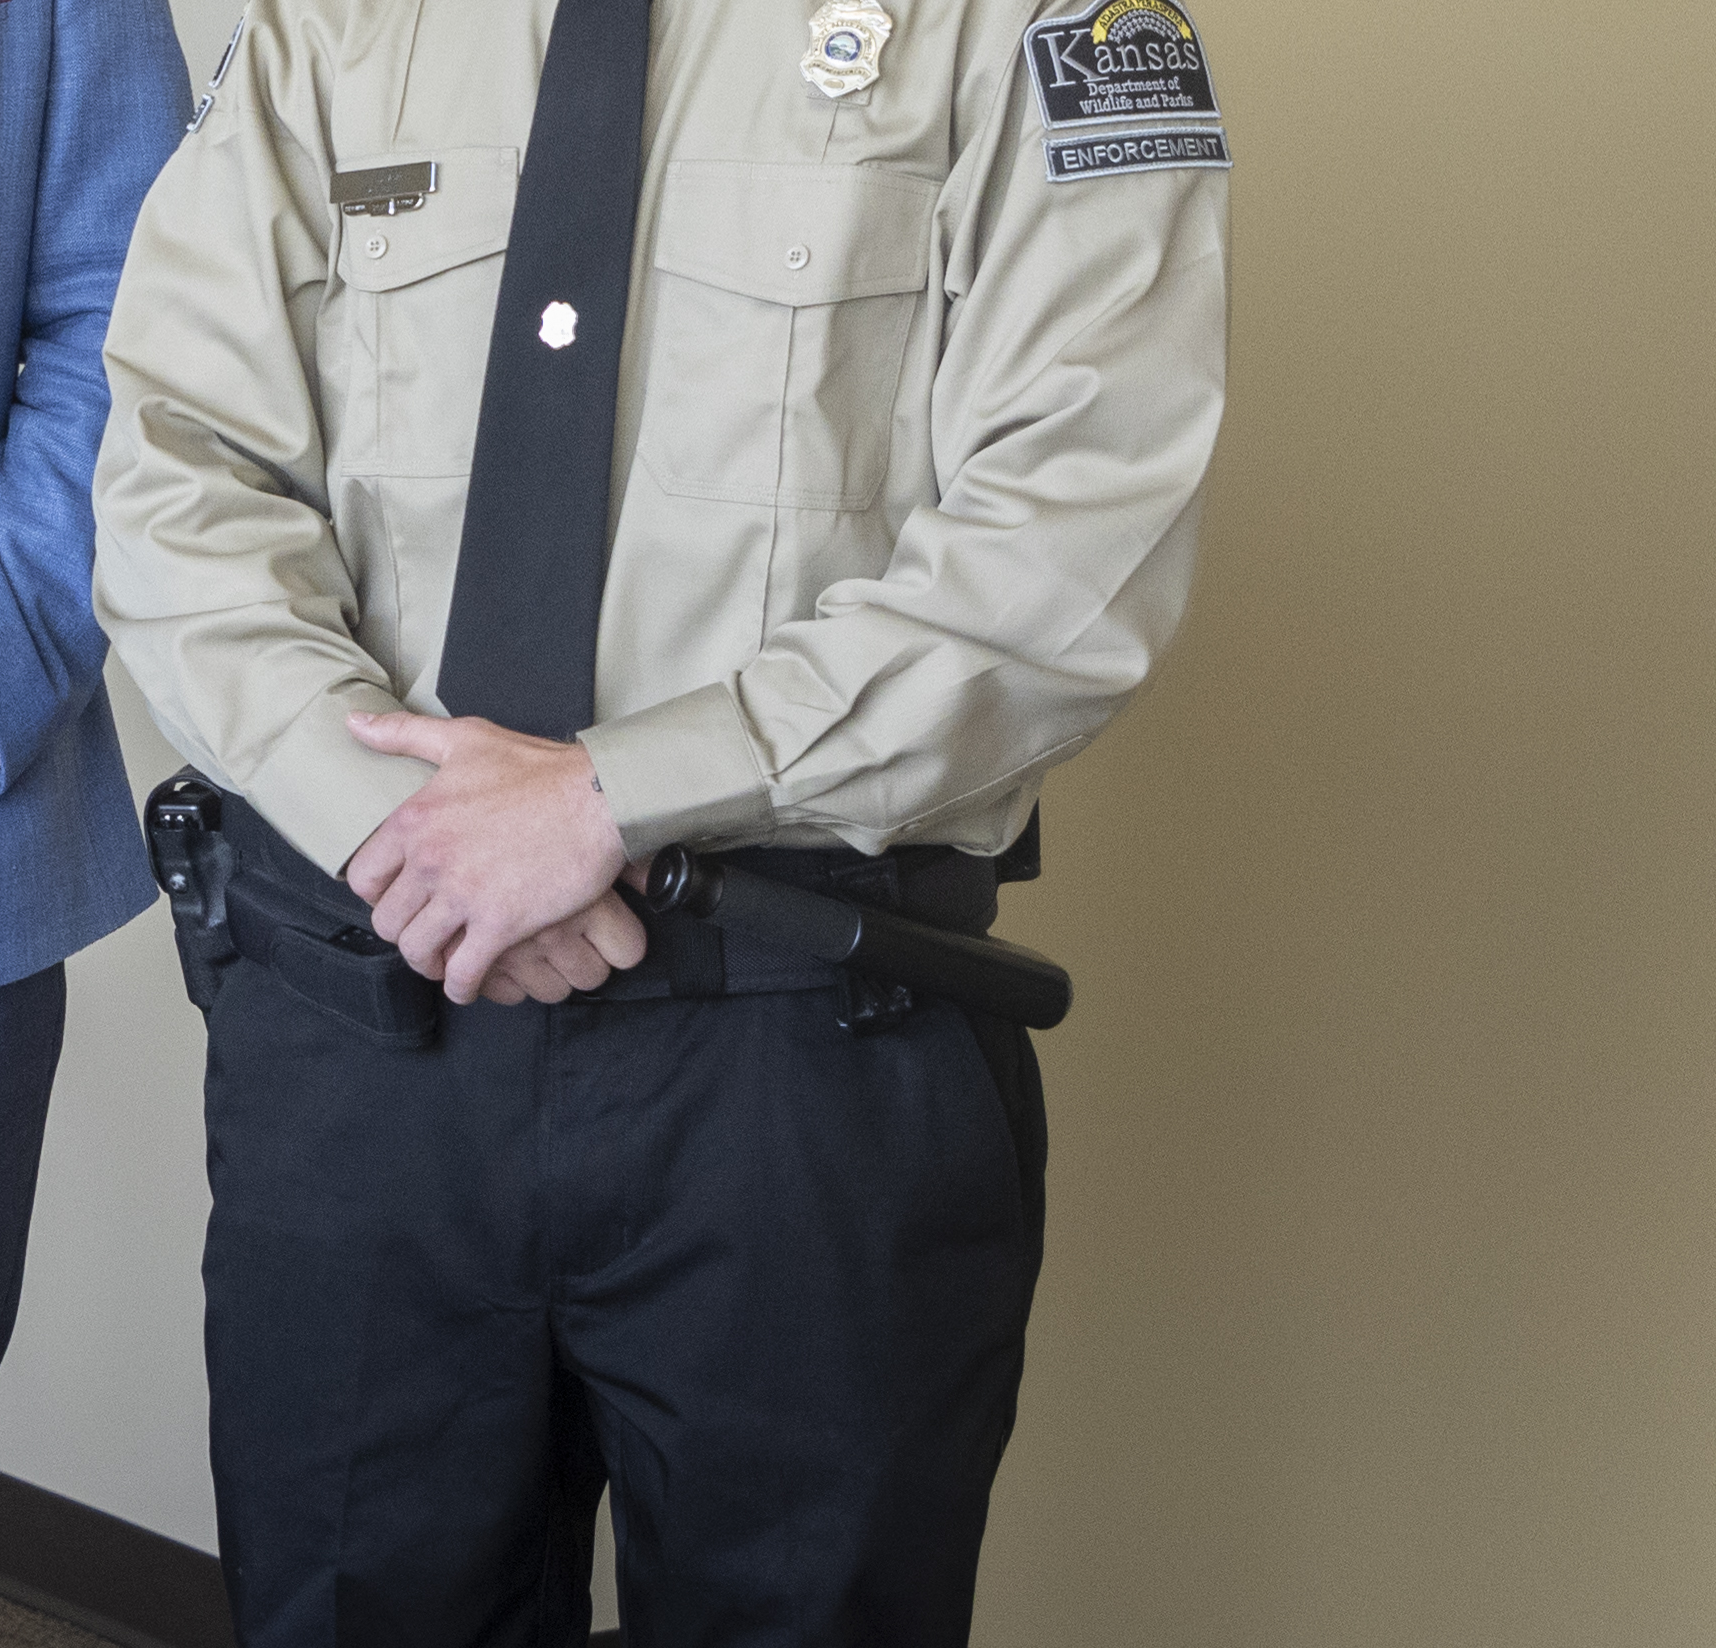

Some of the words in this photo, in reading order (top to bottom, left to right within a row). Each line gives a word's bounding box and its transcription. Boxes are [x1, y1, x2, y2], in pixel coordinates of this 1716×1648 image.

[1037, 27, 1200, 88] Kansas
[1087, 78, 1167, 97] Department
[1167, 75, 1181, 91] of
[1079, 95, 1134, 115] Wildlife
[1135, 93, 1160, 109] and
[1160, 92, 1194, 107] Parks
[1062, 138, 1219, 170] ENFORCEMENT
